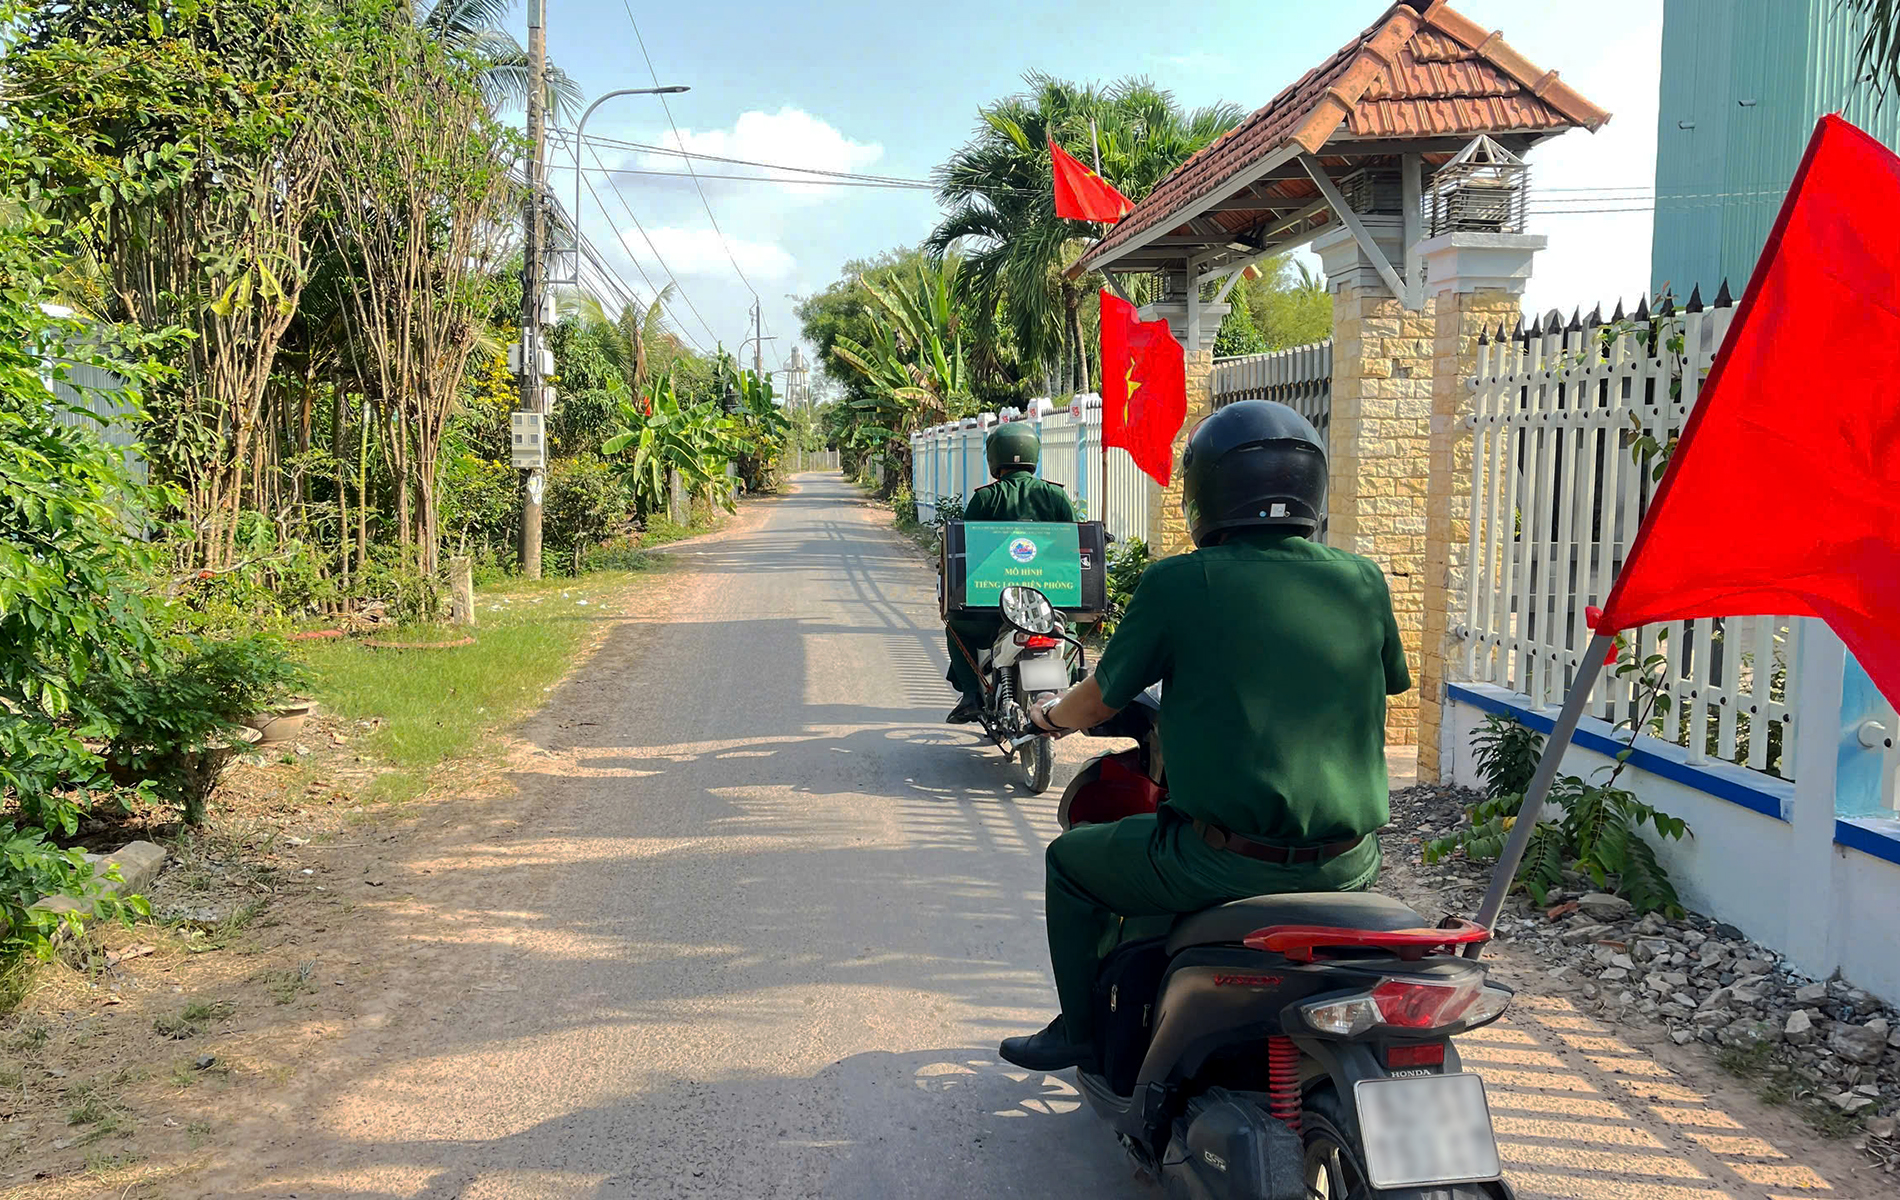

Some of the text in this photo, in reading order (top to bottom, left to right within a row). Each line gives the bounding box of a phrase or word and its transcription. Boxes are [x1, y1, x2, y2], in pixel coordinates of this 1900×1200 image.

[1004, 566, 1043, 576] MÔ HÌNH
[1390, 1069, 1431, 1078] HONDA
